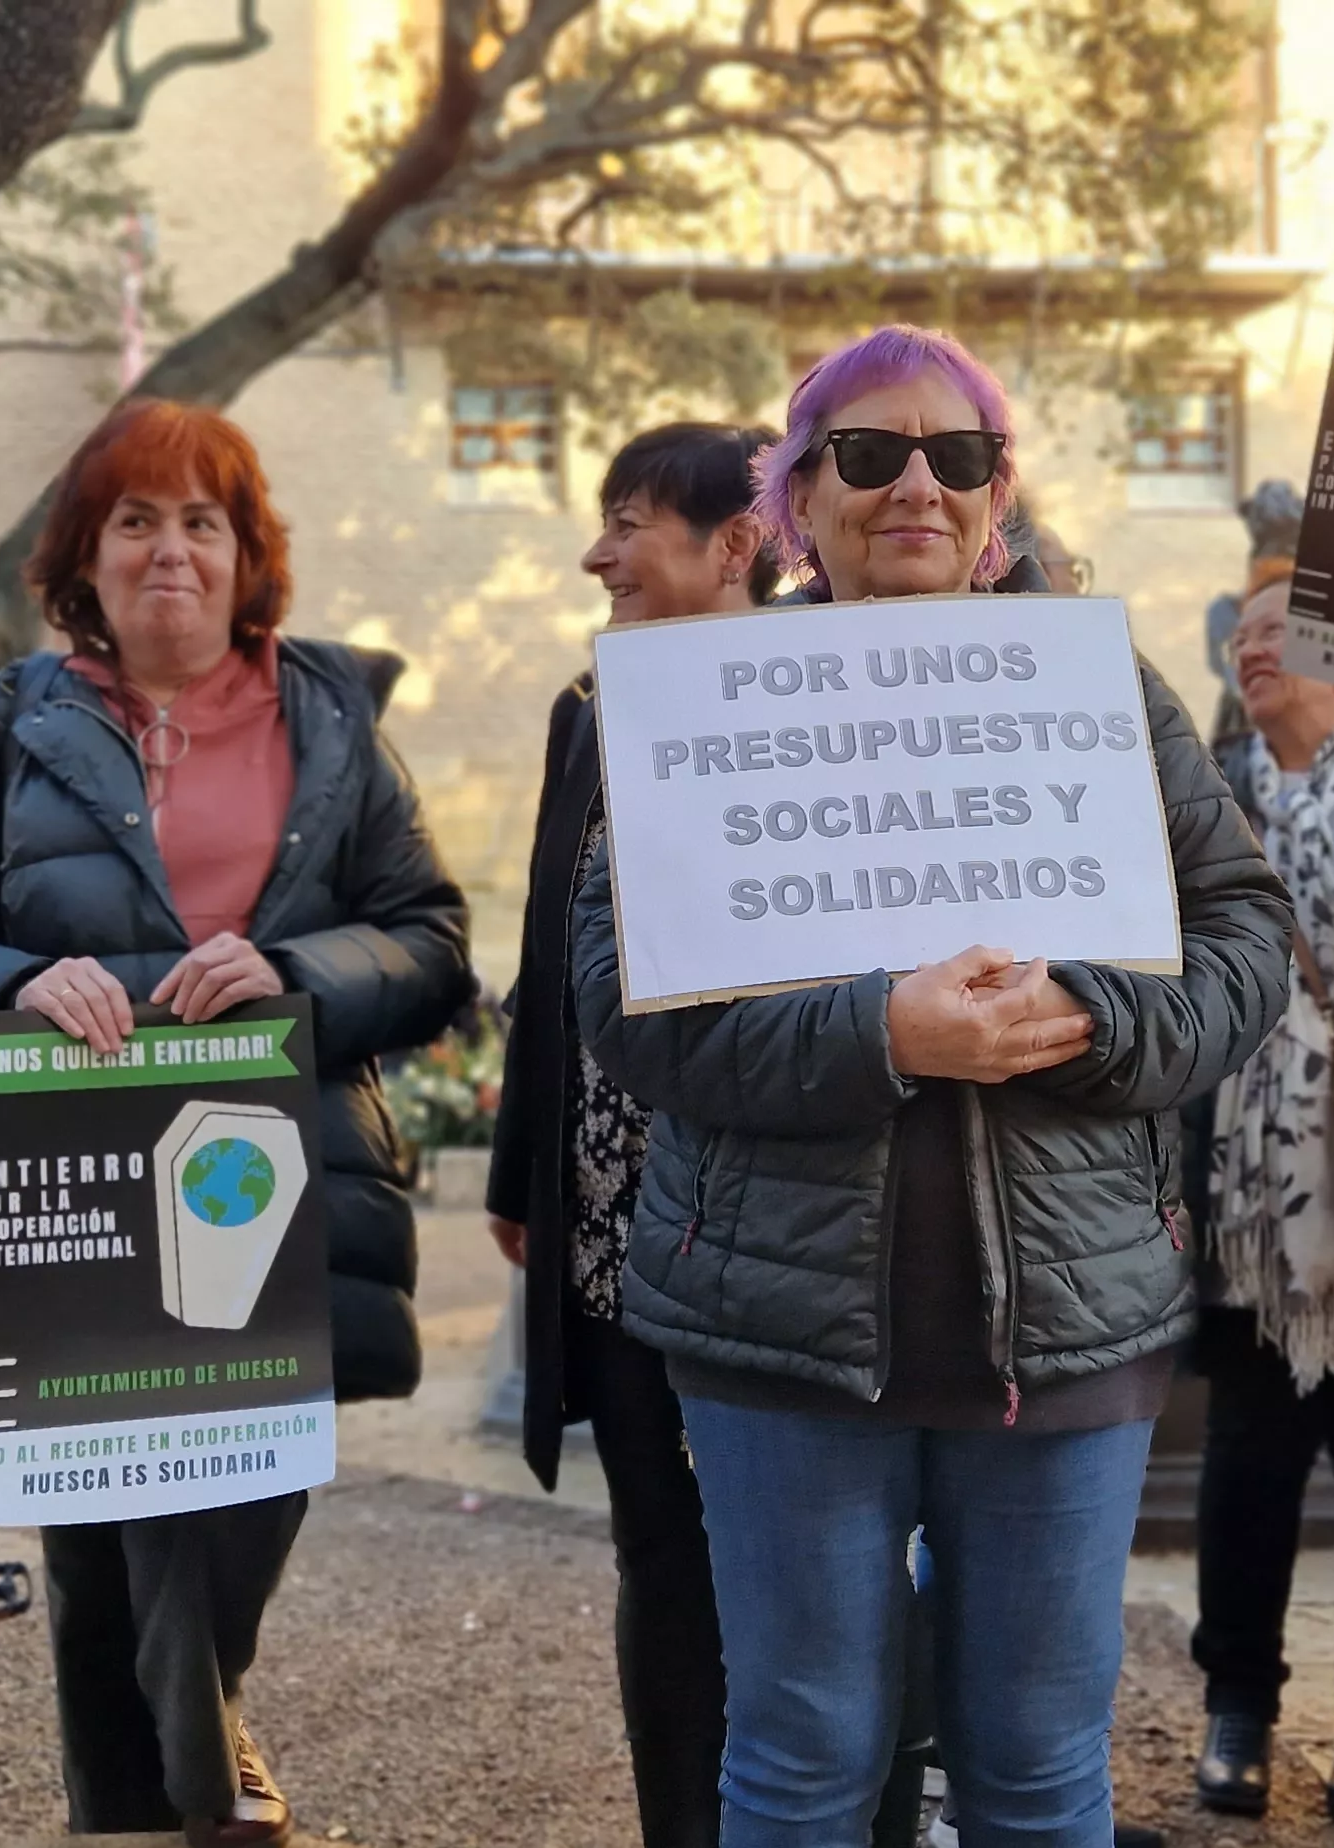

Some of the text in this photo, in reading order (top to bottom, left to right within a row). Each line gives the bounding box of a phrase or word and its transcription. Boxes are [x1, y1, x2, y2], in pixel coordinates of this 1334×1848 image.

[719, 642, 1037, 700] POR UNOS
[651, 711, 1138, 780] PRESUPUESTOS
[723, 783, 1088, 846] SOCIALES Y
[729, 855, 1106, 921] SOLIDARIOS
[154, 1034, 273, 1066] ENTERRAR!
[40, 1189, 71, 1212] LA
[38, 1357, 299, 1399] AYUNTAMIENTO DE HUESCA
[16, 1445, 39, 1463] AL
[50, 1435, 137, 1460] RECORTE
[147, 1431, 171, 1451] EN
[181, 1414, 317, 1448] COOPERACIÓN
[22, 1449, 277, 1495] HUESCA ES SOLIDARIA
